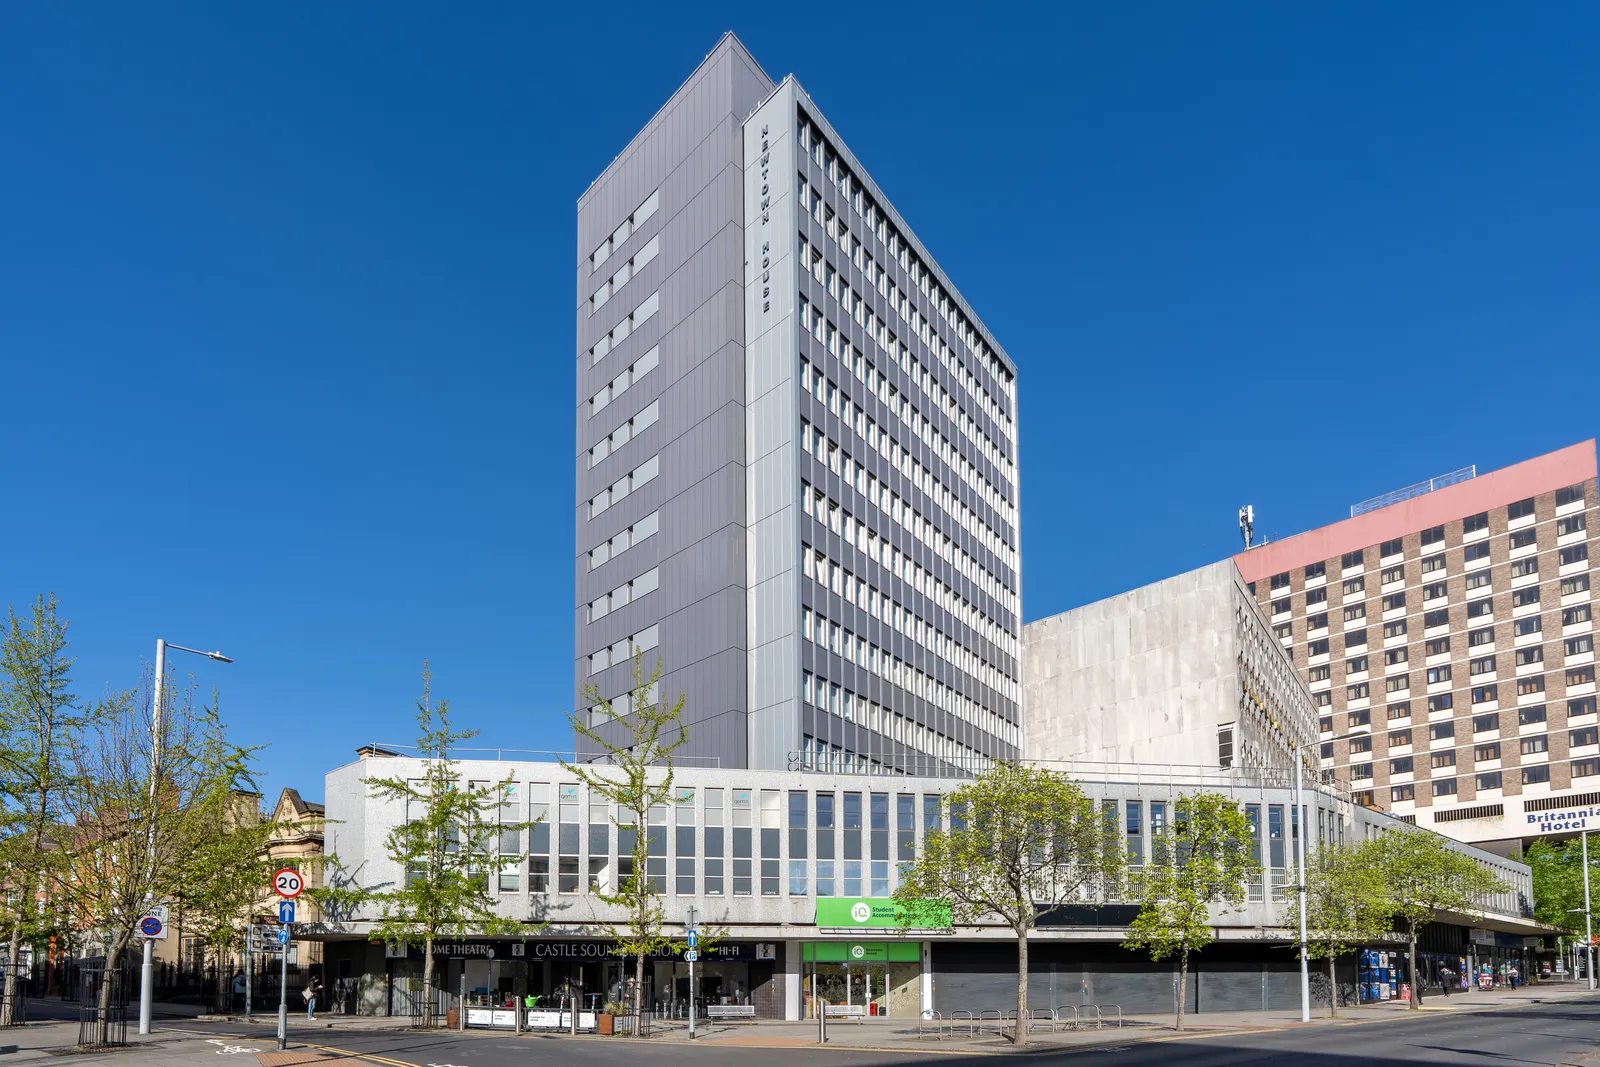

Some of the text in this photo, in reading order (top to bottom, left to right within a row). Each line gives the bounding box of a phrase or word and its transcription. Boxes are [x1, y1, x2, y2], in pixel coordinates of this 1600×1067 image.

[761, 124, 770, 314] NEWTOWN HOUSE
[1527, 808, 1600, 823] Britannia
[1540, 819, 1586, 832] Hotel
[278, 877, 299, 890] 20
[854, 907, 868, 917] iQ
[535, 944, 578, 957] CASTLE
[719, 946, 739, 956] HI-FI
[853, 948, 863, 956] iQ
